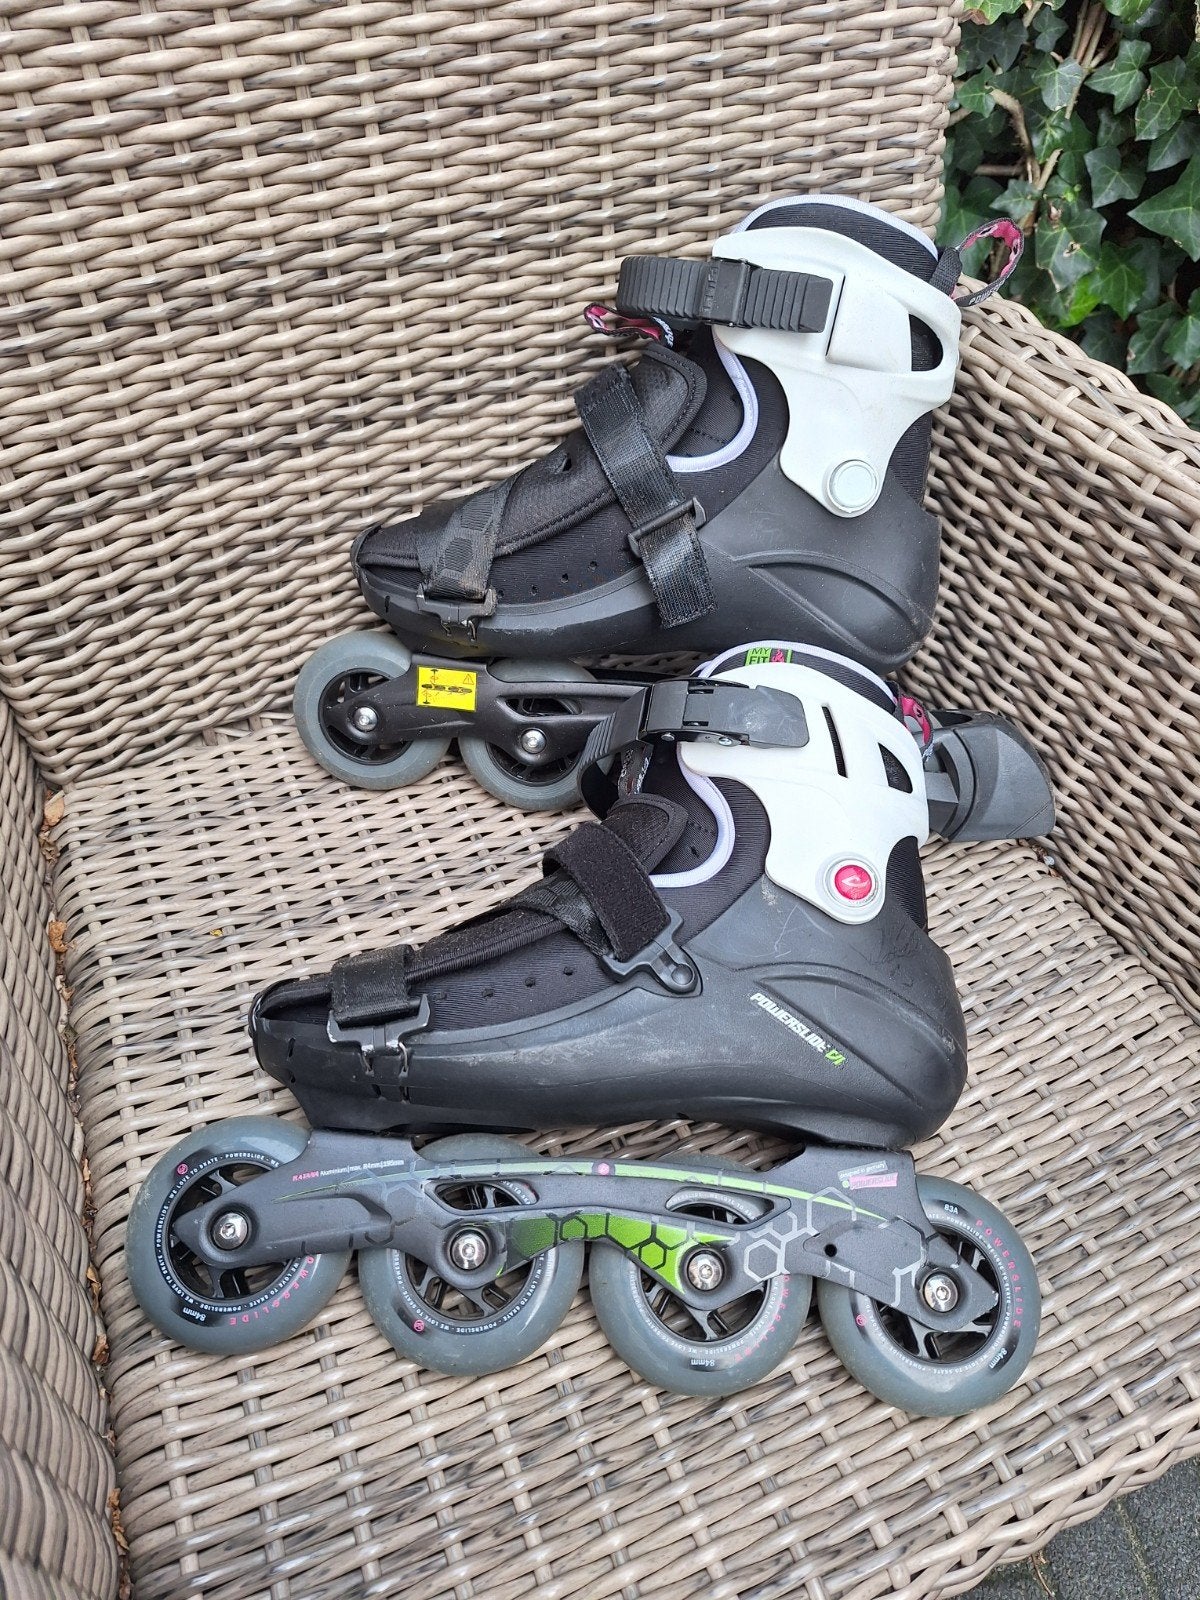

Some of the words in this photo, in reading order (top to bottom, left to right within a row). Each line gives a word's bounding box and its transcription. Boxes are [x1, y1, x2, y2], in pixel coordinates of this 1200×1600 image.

[749, 656, 768, 665] FIT
[750, 992, 831, 1054] POWERSLIDE
[198, 1156, 218, 1169] SKATE
[224, 1151, 265, 1161] POWERSLIDE
[189, 1166, 198, 1175] TO
[175, 1173, 190, 1189] LOVE
[168, 1188, 177, 1199] WE
[944, 1203, 959, 1215] 83A
[156, 1204, 168, 1247] POWERSLIDE
[946, 1215, 983, 1239] POWERSLIDE
[157, 1254, 168, 1275] SKATE
[277, 1272, 292, 1288] LOVE
[975, 1219, 1024, 1328] POWERSLIDE
[170, 1282, 185, 1297] LOVE
[229, 1255, 315, 1327] OWERSLIDE
[269, 1286, 279, 1296] TO
[526, 1280, 538, 1297] LOVE
[184, 1294, 194, 1304] WE
[248, 1293, 269, 1307] SKATE
[402, 1289, 417, 1309] SKATE
[519, 1296, 528, 1306] TO
[182, 1305, 207, 1322] 84mm
[199, 1302, 241, 1312] POWERSLIDE
[502, 1304, 521, 1322] SKATE
[423, 1314, 439, 1326] LOVE
[733, 1273, 792, 1363] OWERSLIDE
[439, 1322, 450, 1331] WE
[455, 1321, 497, 1333] POWERSLIDE
[690, 1358, 716, 1367] 84mm
[988, 1347, 1008, 1369] 84mm
